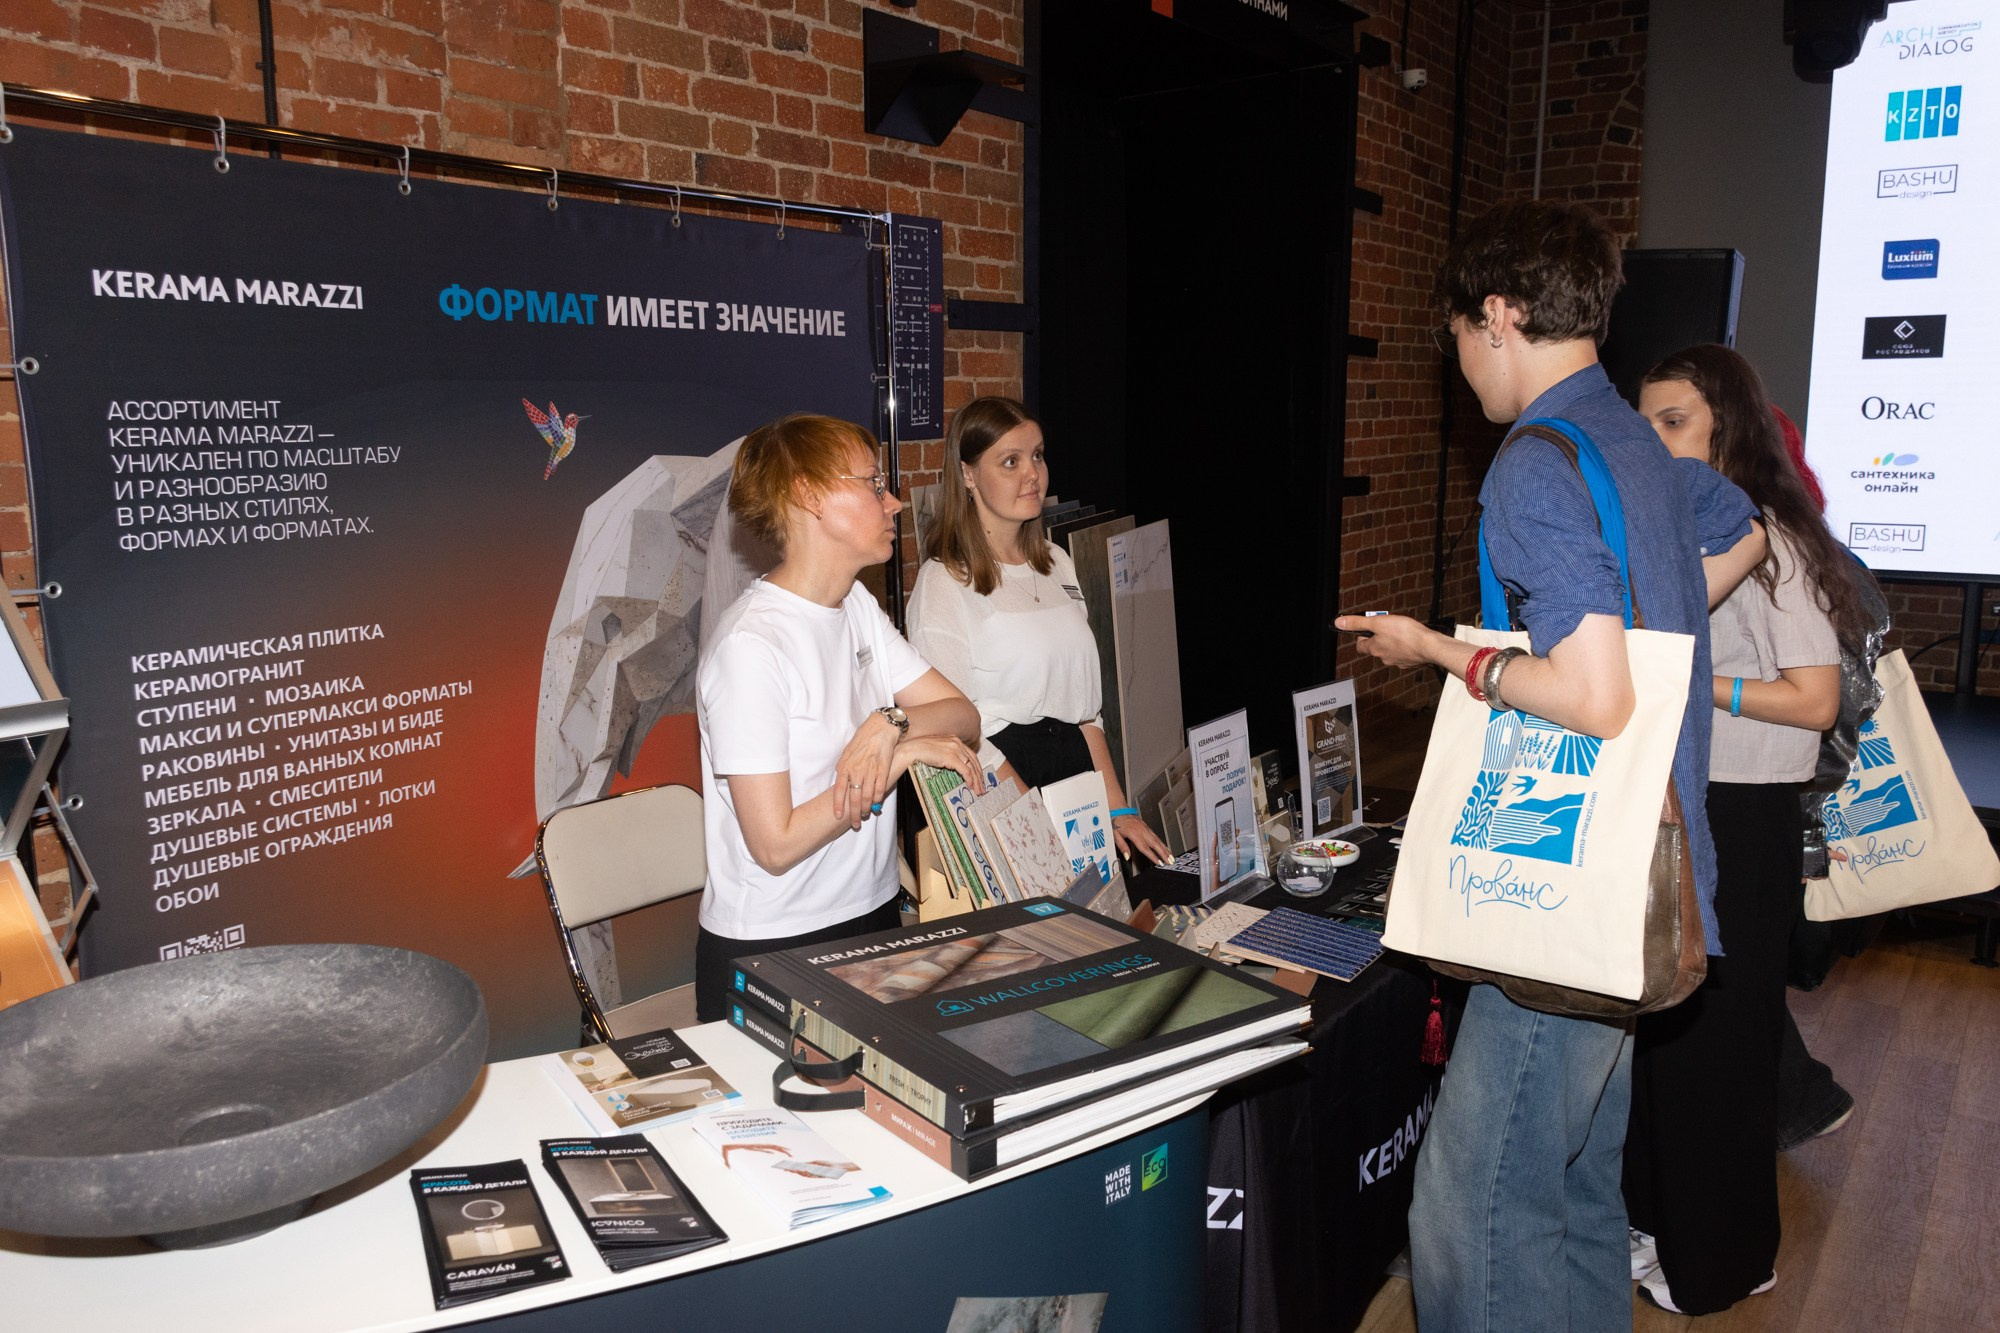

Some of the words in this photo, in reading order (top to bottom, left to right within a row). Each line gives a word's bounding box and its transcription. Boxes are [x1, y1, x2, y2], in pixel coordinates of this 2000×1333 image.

[1880, 25, 1933, 46] ARCH
[1899, 37, 1973, 60] DIALOG
[1887, 103, 1958, 124] KZTO
[1883, 170, 1952, 189] BASHU
[1899, 189, 1933, 199] design
[92, 269, 230, 303] KERAMA
[236, 278, 364, 310] MARAZZI
[439, 284, 599, 326] ФОРМАТ
[606, 296, 709, 330] ИМЕЕТ
[716, 302, 846, 337] ЗНАЧЕНИЕ
[107, 401, 281, 421] АССОРТИМЕНТ
[109, 427, 213, 448] KERAMA
[218, 425, 314, 445] MARAZZI
[111, 451, 242, 474] УНИКАЛЕН
[249, 449, 278, 469] ПО
[284, 446, 401, 468] МАСШТАБУ
[1851, 470, 1935, 480] сантехника
[114, 480, 134, 501] И
[139, 472, 328, 500] РАЗНООБРАЗИЮ
[1864, 482, 1919, 493] онлайн
[117, 507, 134, 526] В
[141, 501, 239, 525] РАЗНЫХ
[245, 496, 334, 518] СТИЛЯХ,
[120, 527, 226, 552] ФОРМАХ
[231, 526, 248, 545] И
[253, 517, 374, 541] ФОРМАТАХ.
[1854, 528, 1921, 543] BASHU
[1870, 543, 1902, 553] design
[132, 634, 303, 673] КЕРАМИЧЕСКАЯ
[308, 624, 385, 649] ПЛИТКА
[134, 660, 305, 700] КЕРАМОГРАНИТ
[136, 696, 237, 727] СТУПЕНИ
[265, 675, 365, 706] МОЗАИКА
[1304, 702, 1320, 712] KERAMA
[139, 725, 222, 754] МАКСИ
[227, 722, 243, 739] И
[247, 697, 378, 735] СУПЕРМАКСИ
[382, 680, 473, 710] ФОРМАТЫ
[142, 743, 265, 781] РАКОВИНЫ
[288, 721, 378, 752] УНИТАЗЫ
[382, 718, 395, 733] И
[399, 708, 444, 731] БИДЕ
[1198, 736, 1214, 748] KERAMA
[1204, 749, 1230, 767] УЧАСТВУЙ
[145, 776, 231, 808] МЕБЕЛЬ
[236, 767, 278, 792] ДЛЯ
[283, 749, 365, 778] ВАННЫХ
[369, 732, 444, 760] КОМНАТ
[1205, 769, 1210, 778] В
[1210, 762, 1229, 776] ОПРОСЕ
[148, 800, 246, 835] ЗЕРКАЛА
[269, 768, 384, 807] СМЕСИТЕЛИ
[1063, 807, 1081, 818] KERAMA
[151, 822, 258, 864] ДУШЕВЫЕ
[263, 799, 358, 834] СИСТЕМЫ
[378, 779, 436, 807] ЛОТКИ
[1576, 791, 1598, 868] kerama-marazzi.com
[153, 847, 260, 890] ДУШЕВЫЕ
[264, 814, 393, 858] ОГРАЖДЕНИЯ
[155, 883, 220, 913] ОБОИ
[1034, 905, 1053, 914] 17
[808, 942, 886, 965] KERAMA
[887, 927, 967, 949] MARAZZI
[737, 975, 743, 987] 17
[970, 954, 1154, 1007] WALLCOVERINGS
[1112, 970, 1132, 978] FRESH
[1137, 962, 1161, 973] TROPHY
[747, 984, 766, 1001] KERAMA
[766, 993, 785, 1013] MARAZZI
[746, 1019, 765, 1037] KERAMA
[765, 1029, 785, 1050] MARAZZI
[889, 1074, 905, 1089] FRESH
[911, 1087, 932, 1107] TROPHY
[891, 1113, 912, 1133] МИРАЖ
[915, 1129, 936, 1148] MIRAGE
[561, 1148, 607, 1156] КАЖДОЙ
[1105, 1164, 1131, 1184] MADE
[1144, 1158, 1166, 1177] ECO
[422, 1180, 471, 1188] КРАСОТА
[433, 1182, 483, 1192] КАЖДОЙ
[484, 1179, 527, 1189] ДЕТАЛИ
[1105, 1175, 1131, 1194] WITH
[1106, 1185, 1131, 1205] ITALY
[446, 1263, 516, 1280] CARAVÁN
